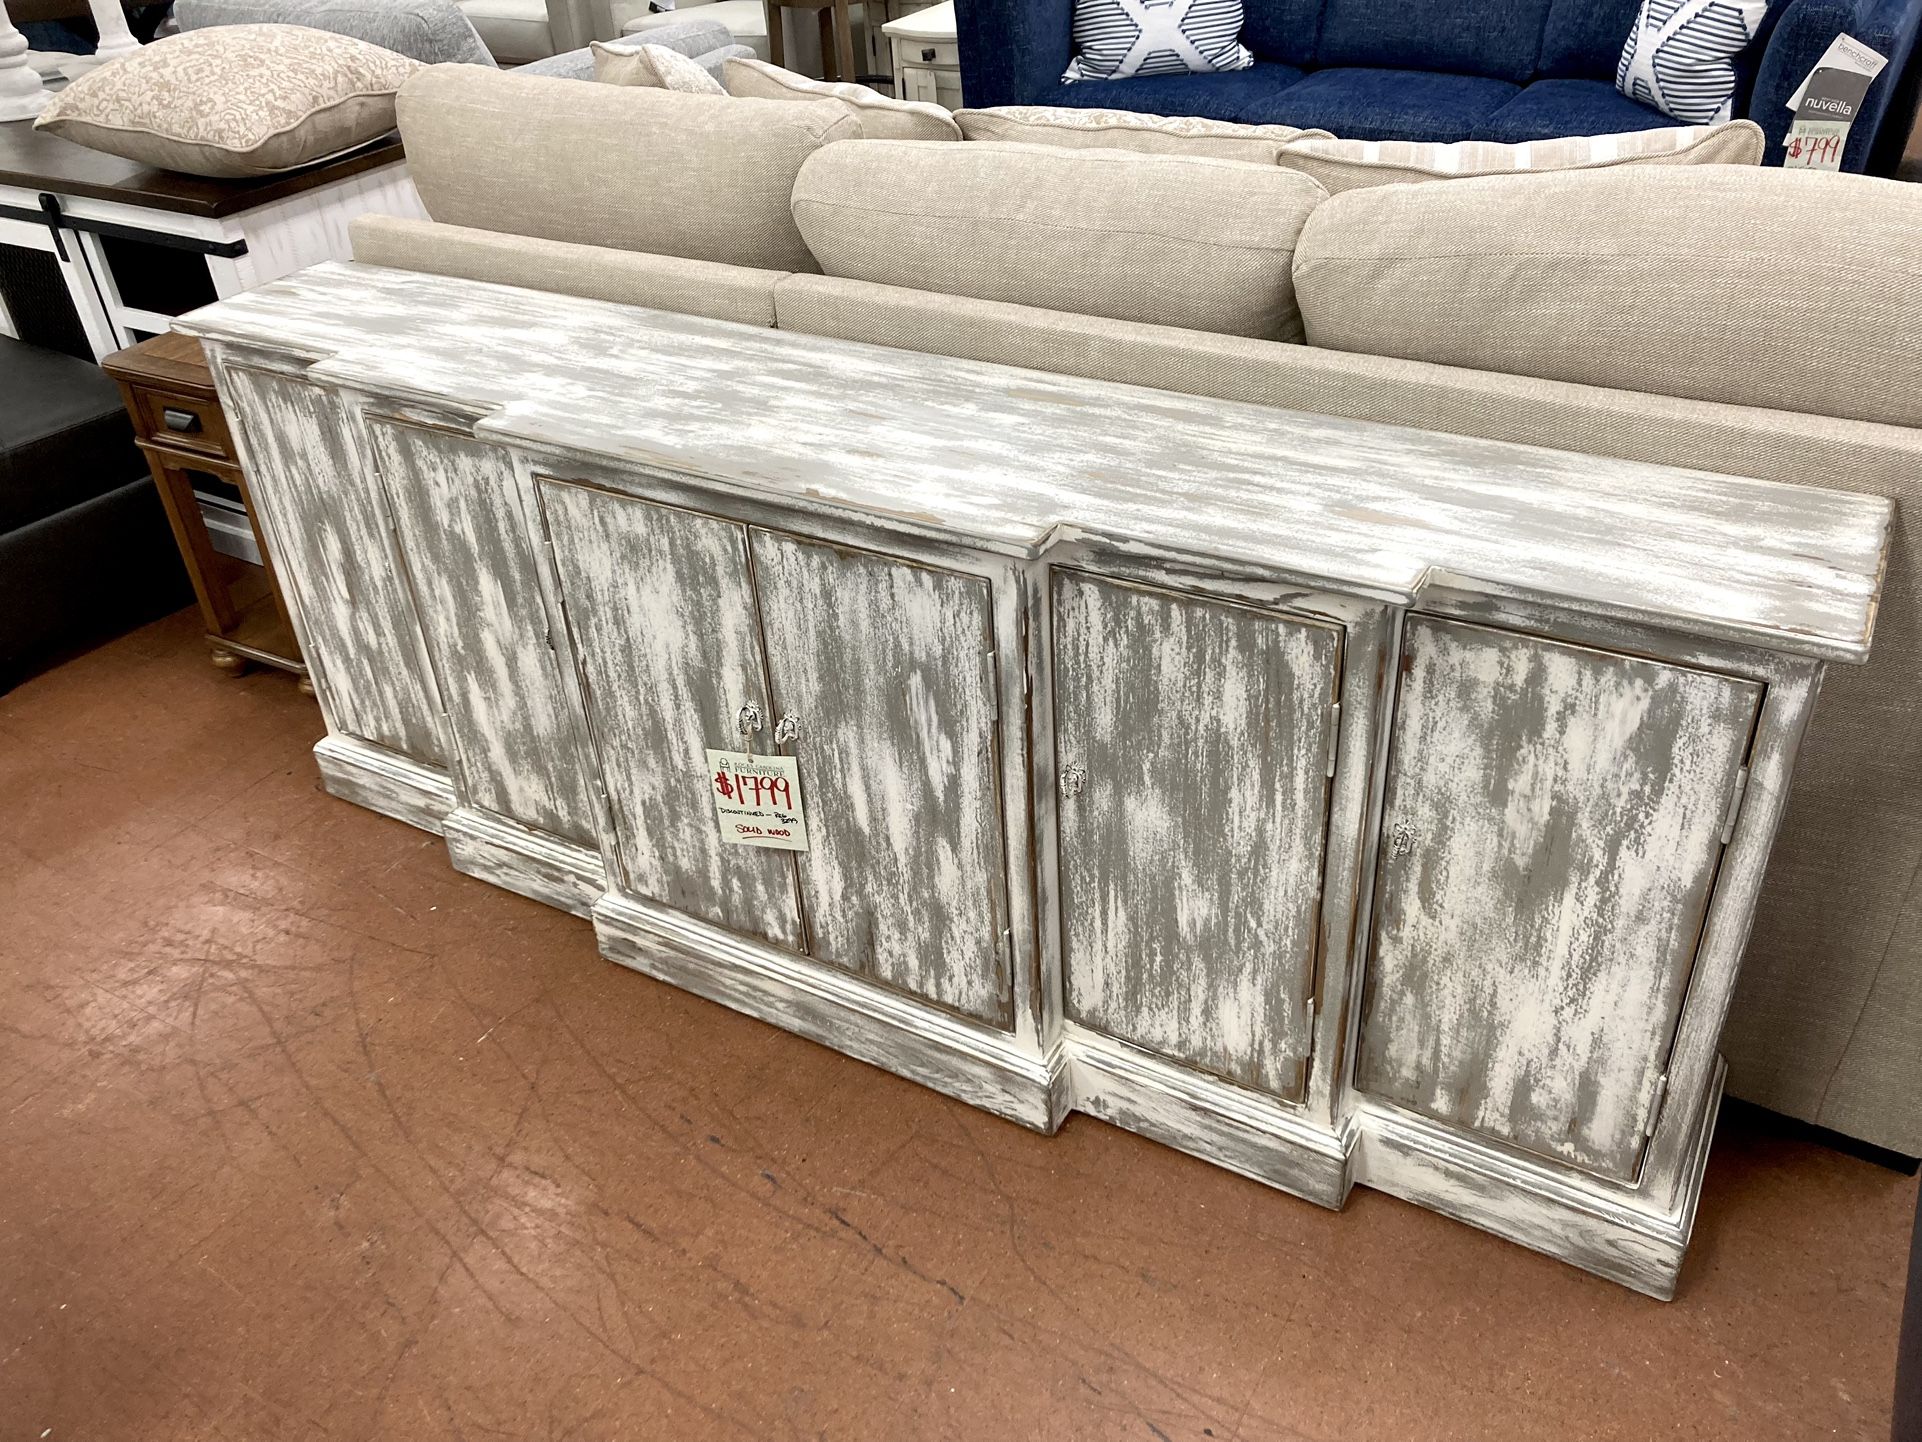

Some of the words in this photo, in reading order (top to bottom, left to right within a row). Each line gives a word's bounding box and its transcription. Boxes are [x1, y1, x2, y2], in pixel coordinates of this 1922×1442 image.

[1805, 98, 1852, 115] nuvella
[1788, 135, 1840, 165] $799
[734, 766, 786, 777] FURNITURE
[714, 771, 792, 810] $1799
[735, 824, 763, 834] SOLID
[767, 829, 791, 837] WOOD
